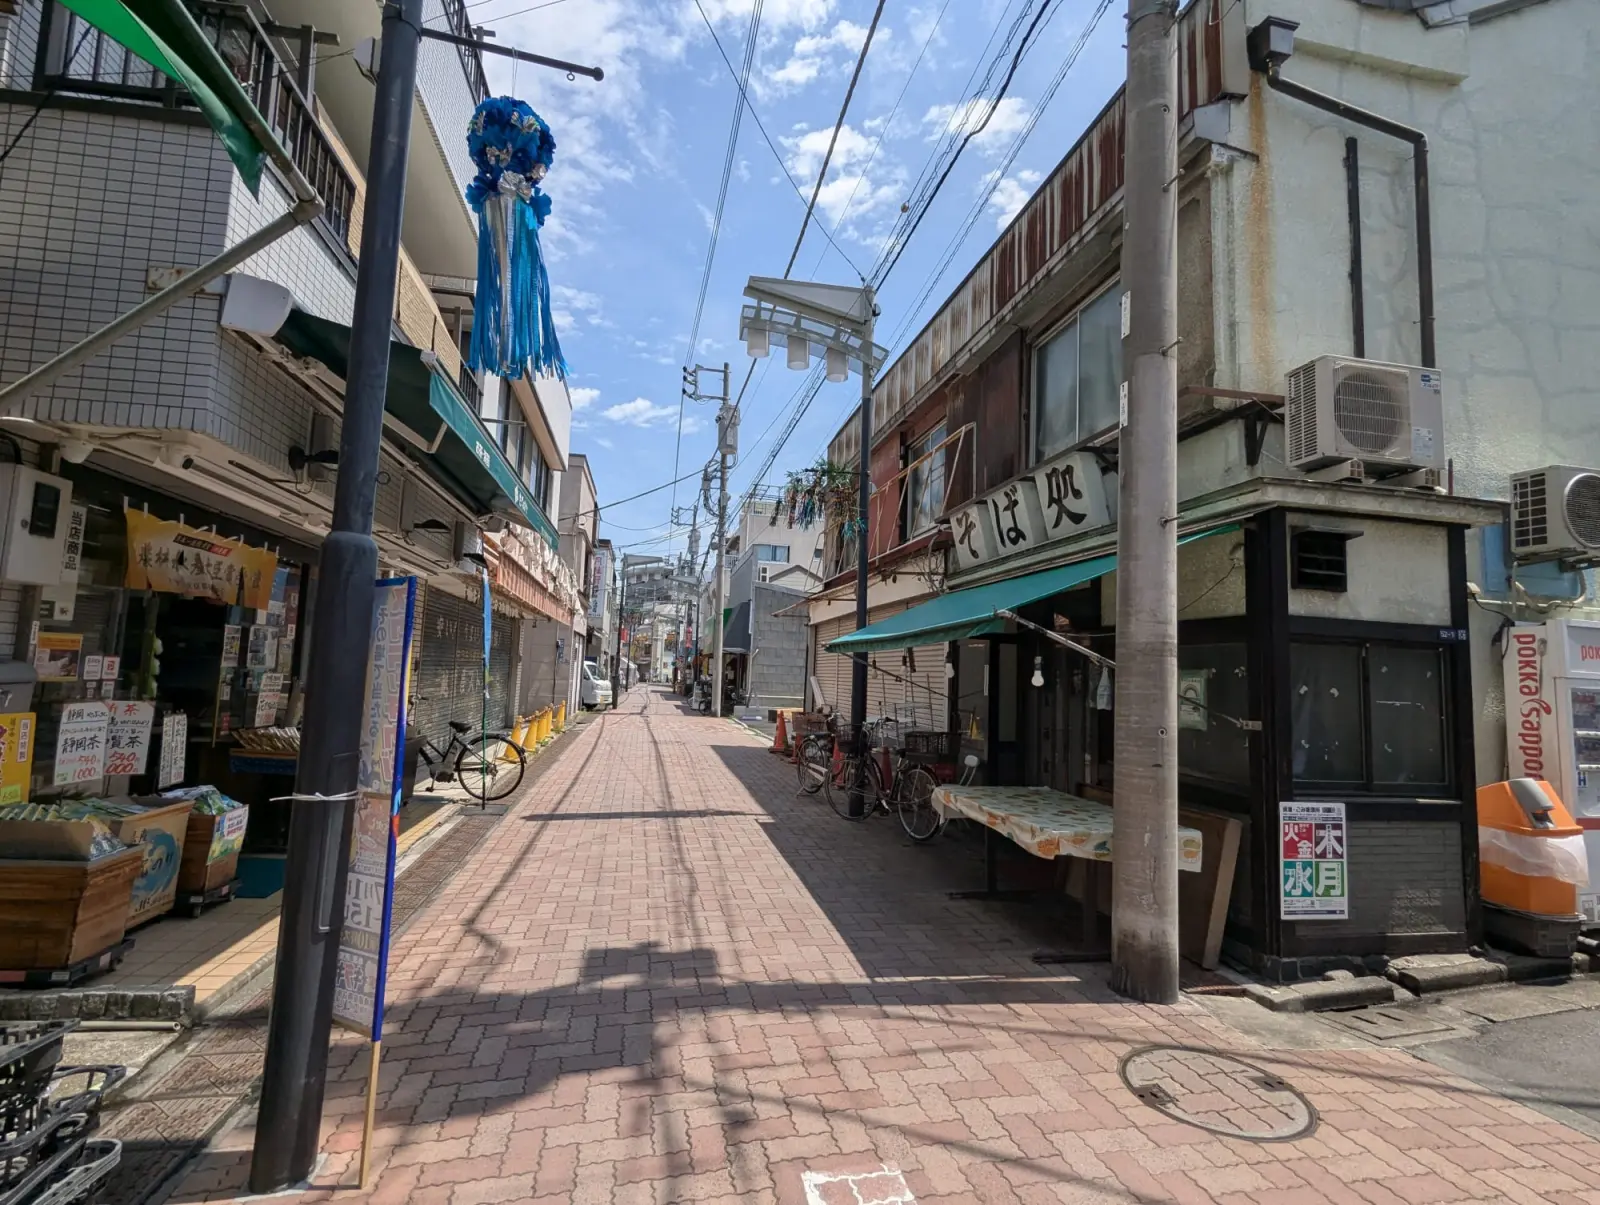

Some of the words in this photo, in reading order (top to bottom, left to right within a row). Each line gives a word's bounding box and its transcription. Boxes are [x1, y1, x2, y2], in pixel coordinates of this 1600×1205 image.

[956, 464, 1087, 559] そば処
[61, 734, 103, 755] 静岡茶
[105, 735, 144, 750] 覧茶
[1284, 822, 1299, 842] 火
[1315, 824, 1344, 858] 木
[1297, 841, 1313, 859] 金
[1284, 861, 1313, 897] 水
[1315, 862, 1342, 896] 月
